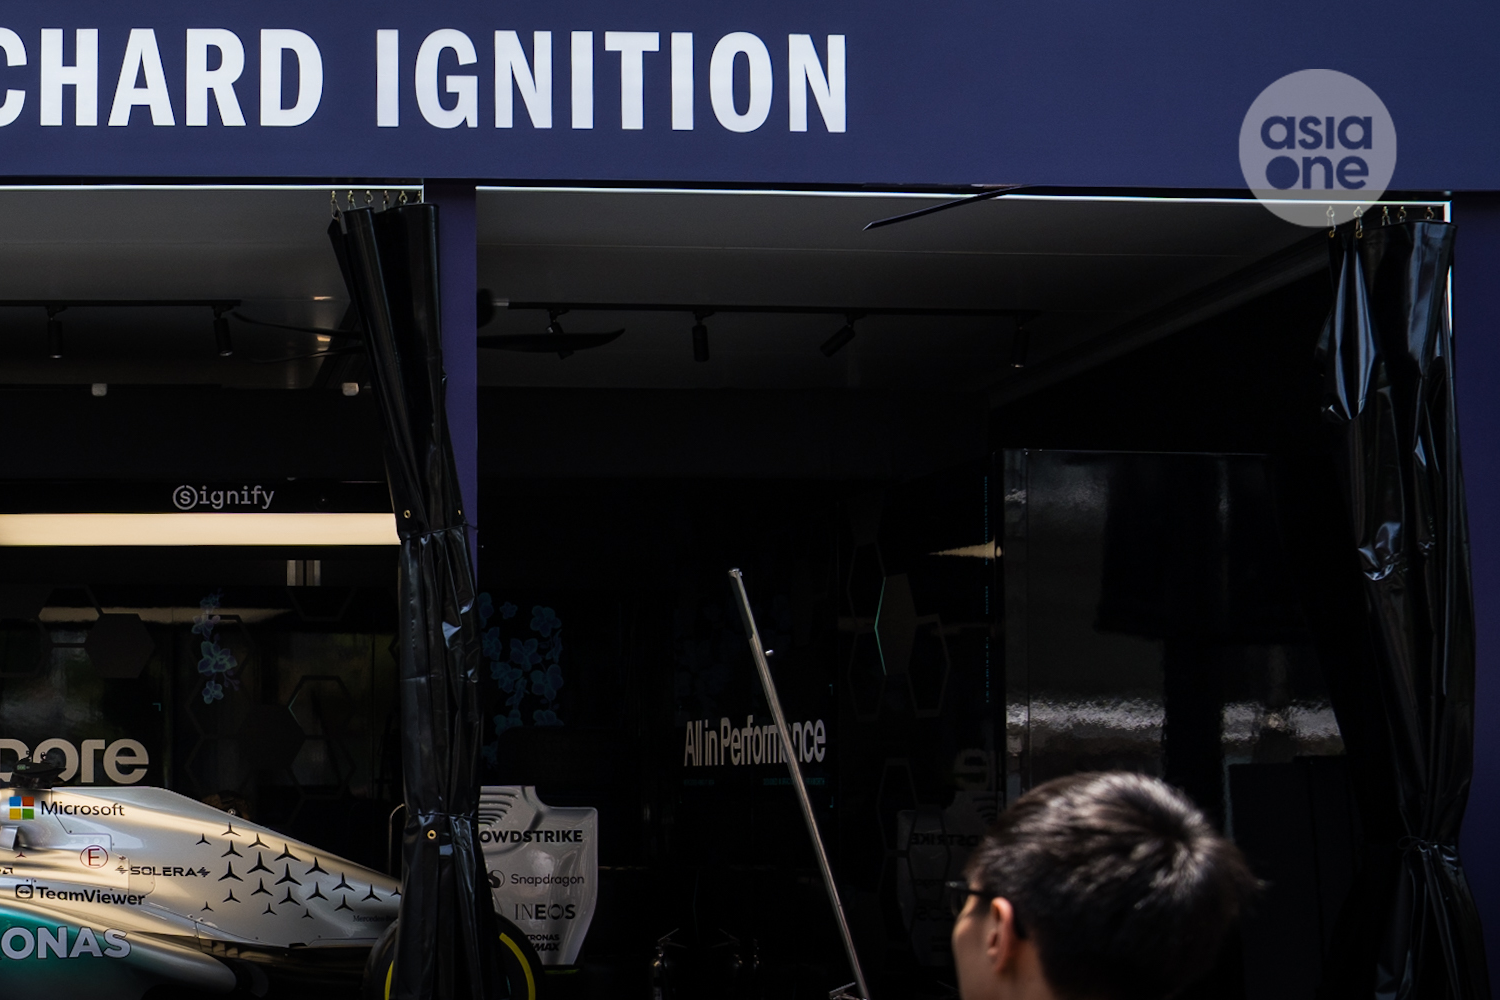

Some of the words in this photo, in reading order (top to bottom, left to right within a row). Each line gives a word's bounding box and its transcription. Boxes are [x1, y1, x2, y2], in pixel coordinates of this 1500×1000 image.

[376, 28, 848, 133] IGNITION
[683, 719, 703, 767] All
[704, 719, 719, 766] in
[720, 714, 827, 766] Performnce
[41, 800, 125, 817] Microsoft
[479, 830, 583, 843] OWDSTRIKE
[130, 866, 198, 877] SOLERA
[510, 873, 585, 887] Snapdragon
[36, 885, 145, 905] TeamViewer
[514, 903, 576, 920] INEOS
